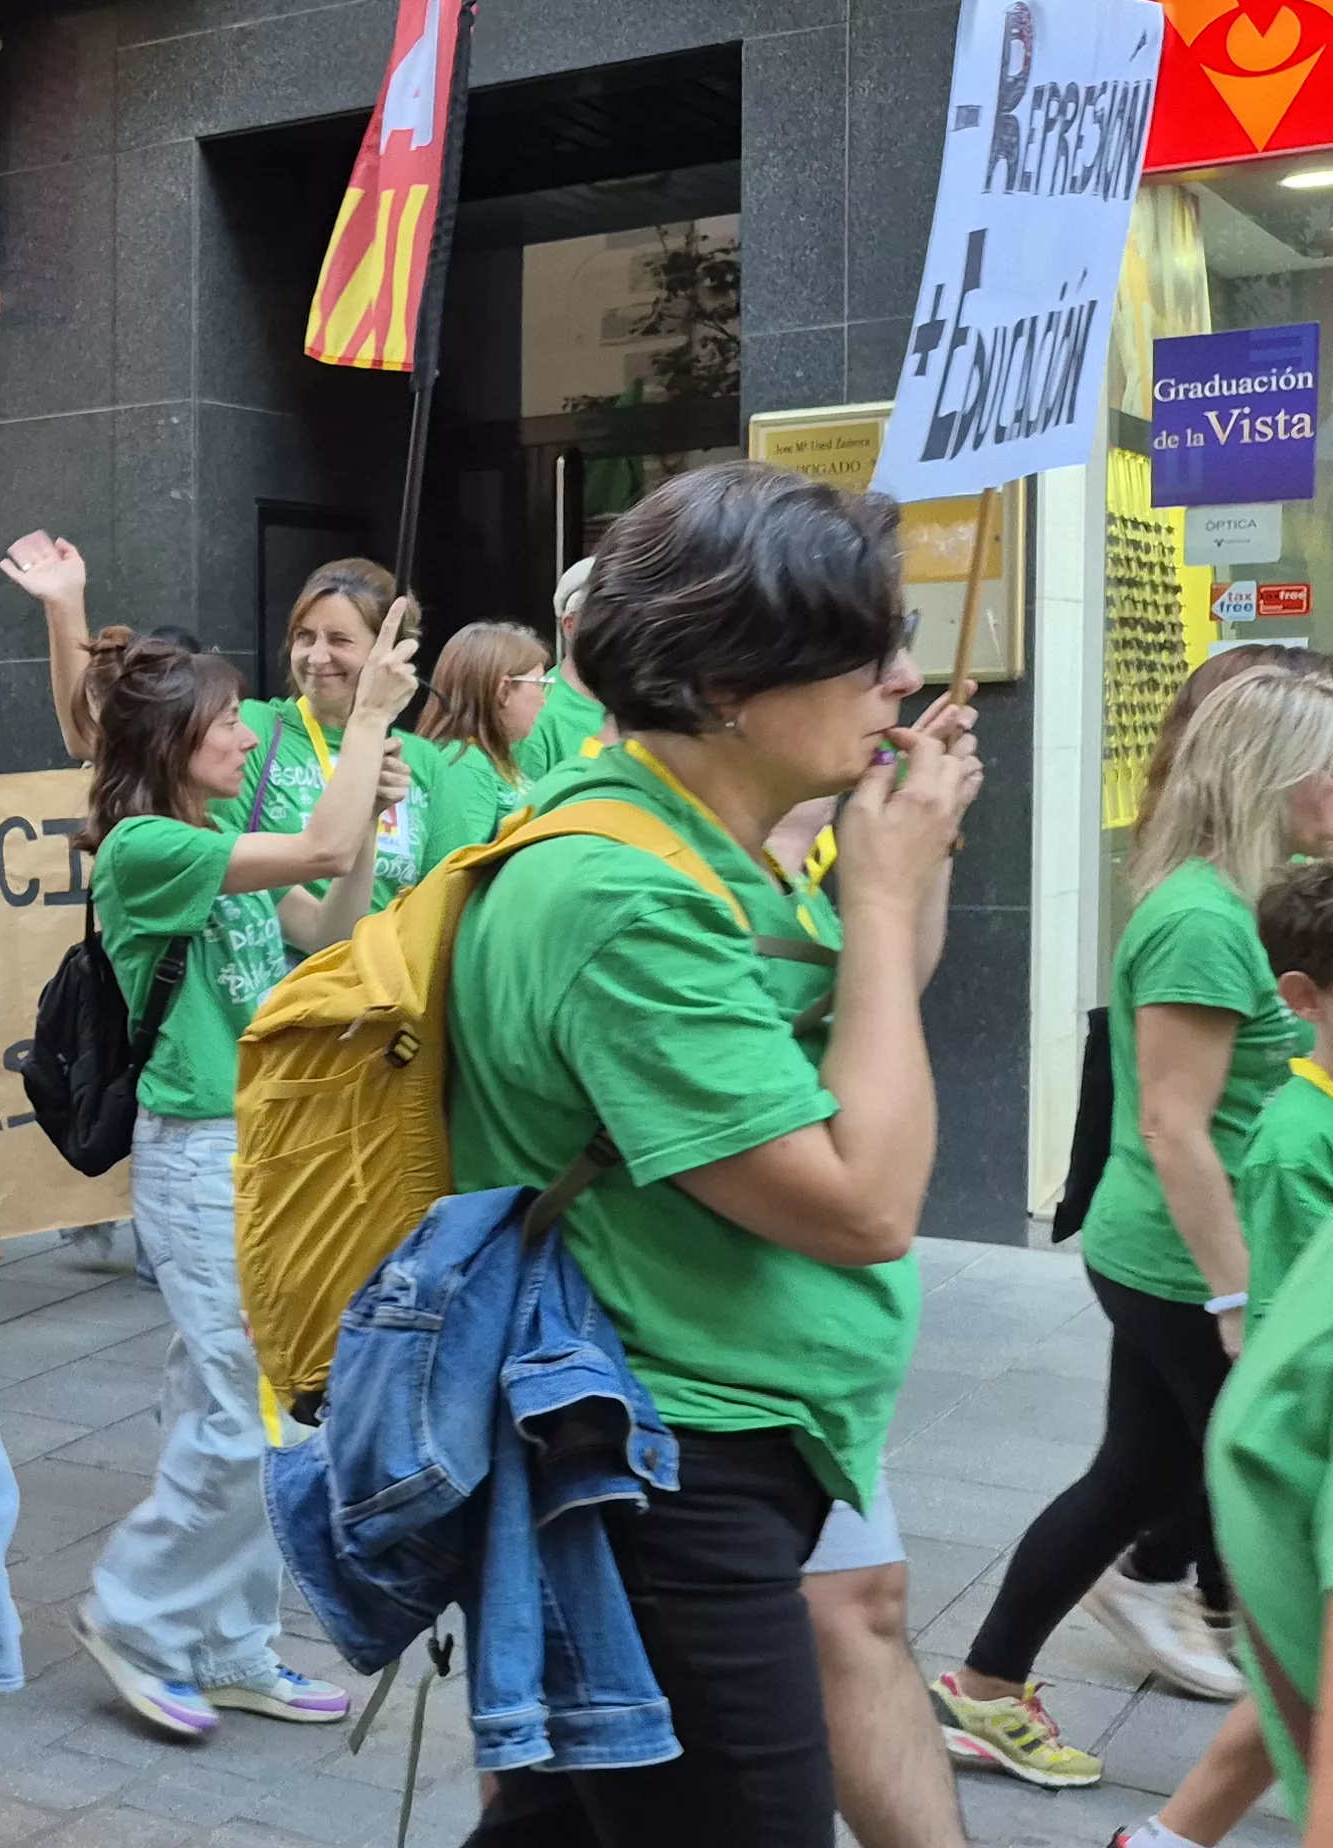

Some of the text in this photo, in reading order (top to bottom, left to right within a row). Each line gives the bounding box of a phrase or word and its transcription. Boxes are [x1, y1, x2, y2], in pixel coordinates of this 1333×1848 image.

[1154, 366, 1313, 402] Graduación
[1154, 407, 1314, 450] de la Vista
[1218, 601, 1254, 613] free
[1228, 591, 1253, 601] tax
